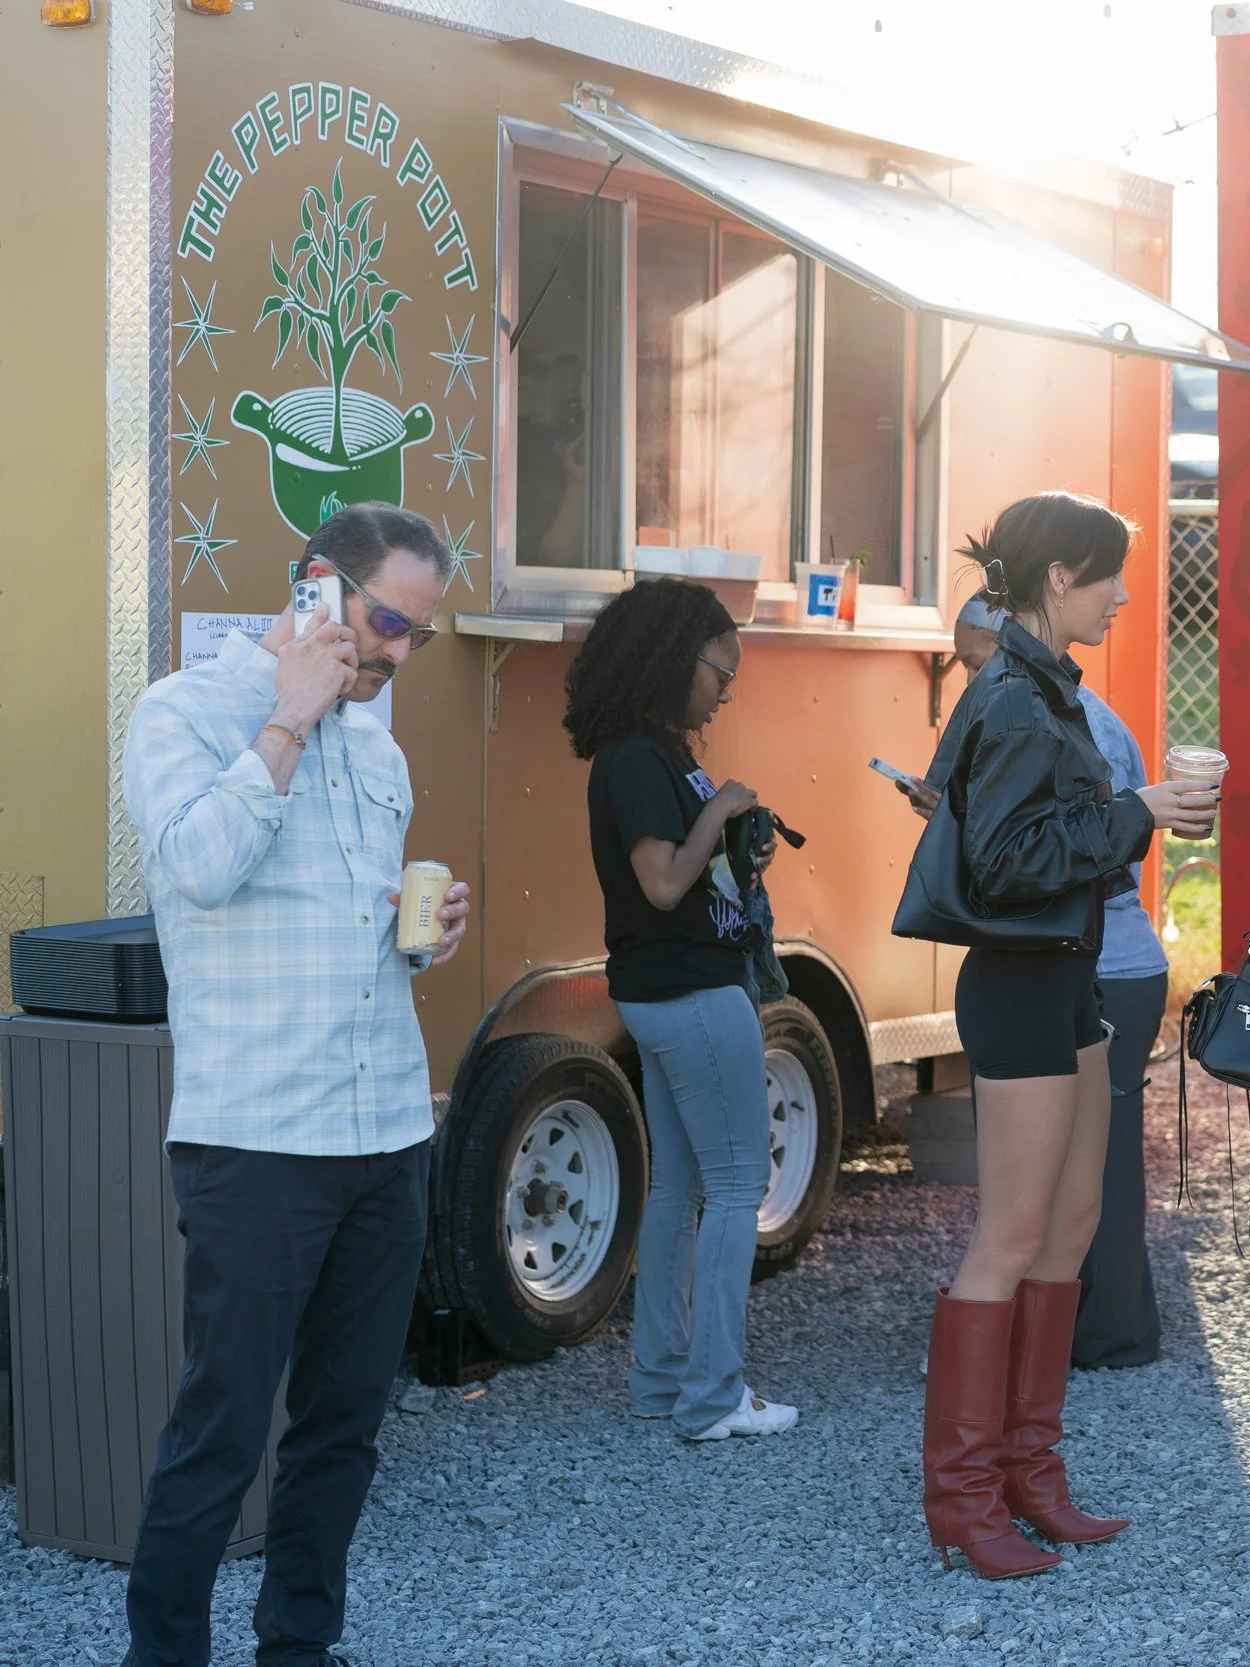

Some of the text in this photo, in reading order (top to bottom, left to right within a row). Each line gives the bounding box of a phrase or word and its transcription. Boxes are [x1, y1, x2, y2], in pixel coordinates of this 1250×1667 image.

[177, 81, 478, 292] THE PEPPER POTT
[196, 617, 244, 630] CHANNA
[418, 895, 433, 928] BIER
